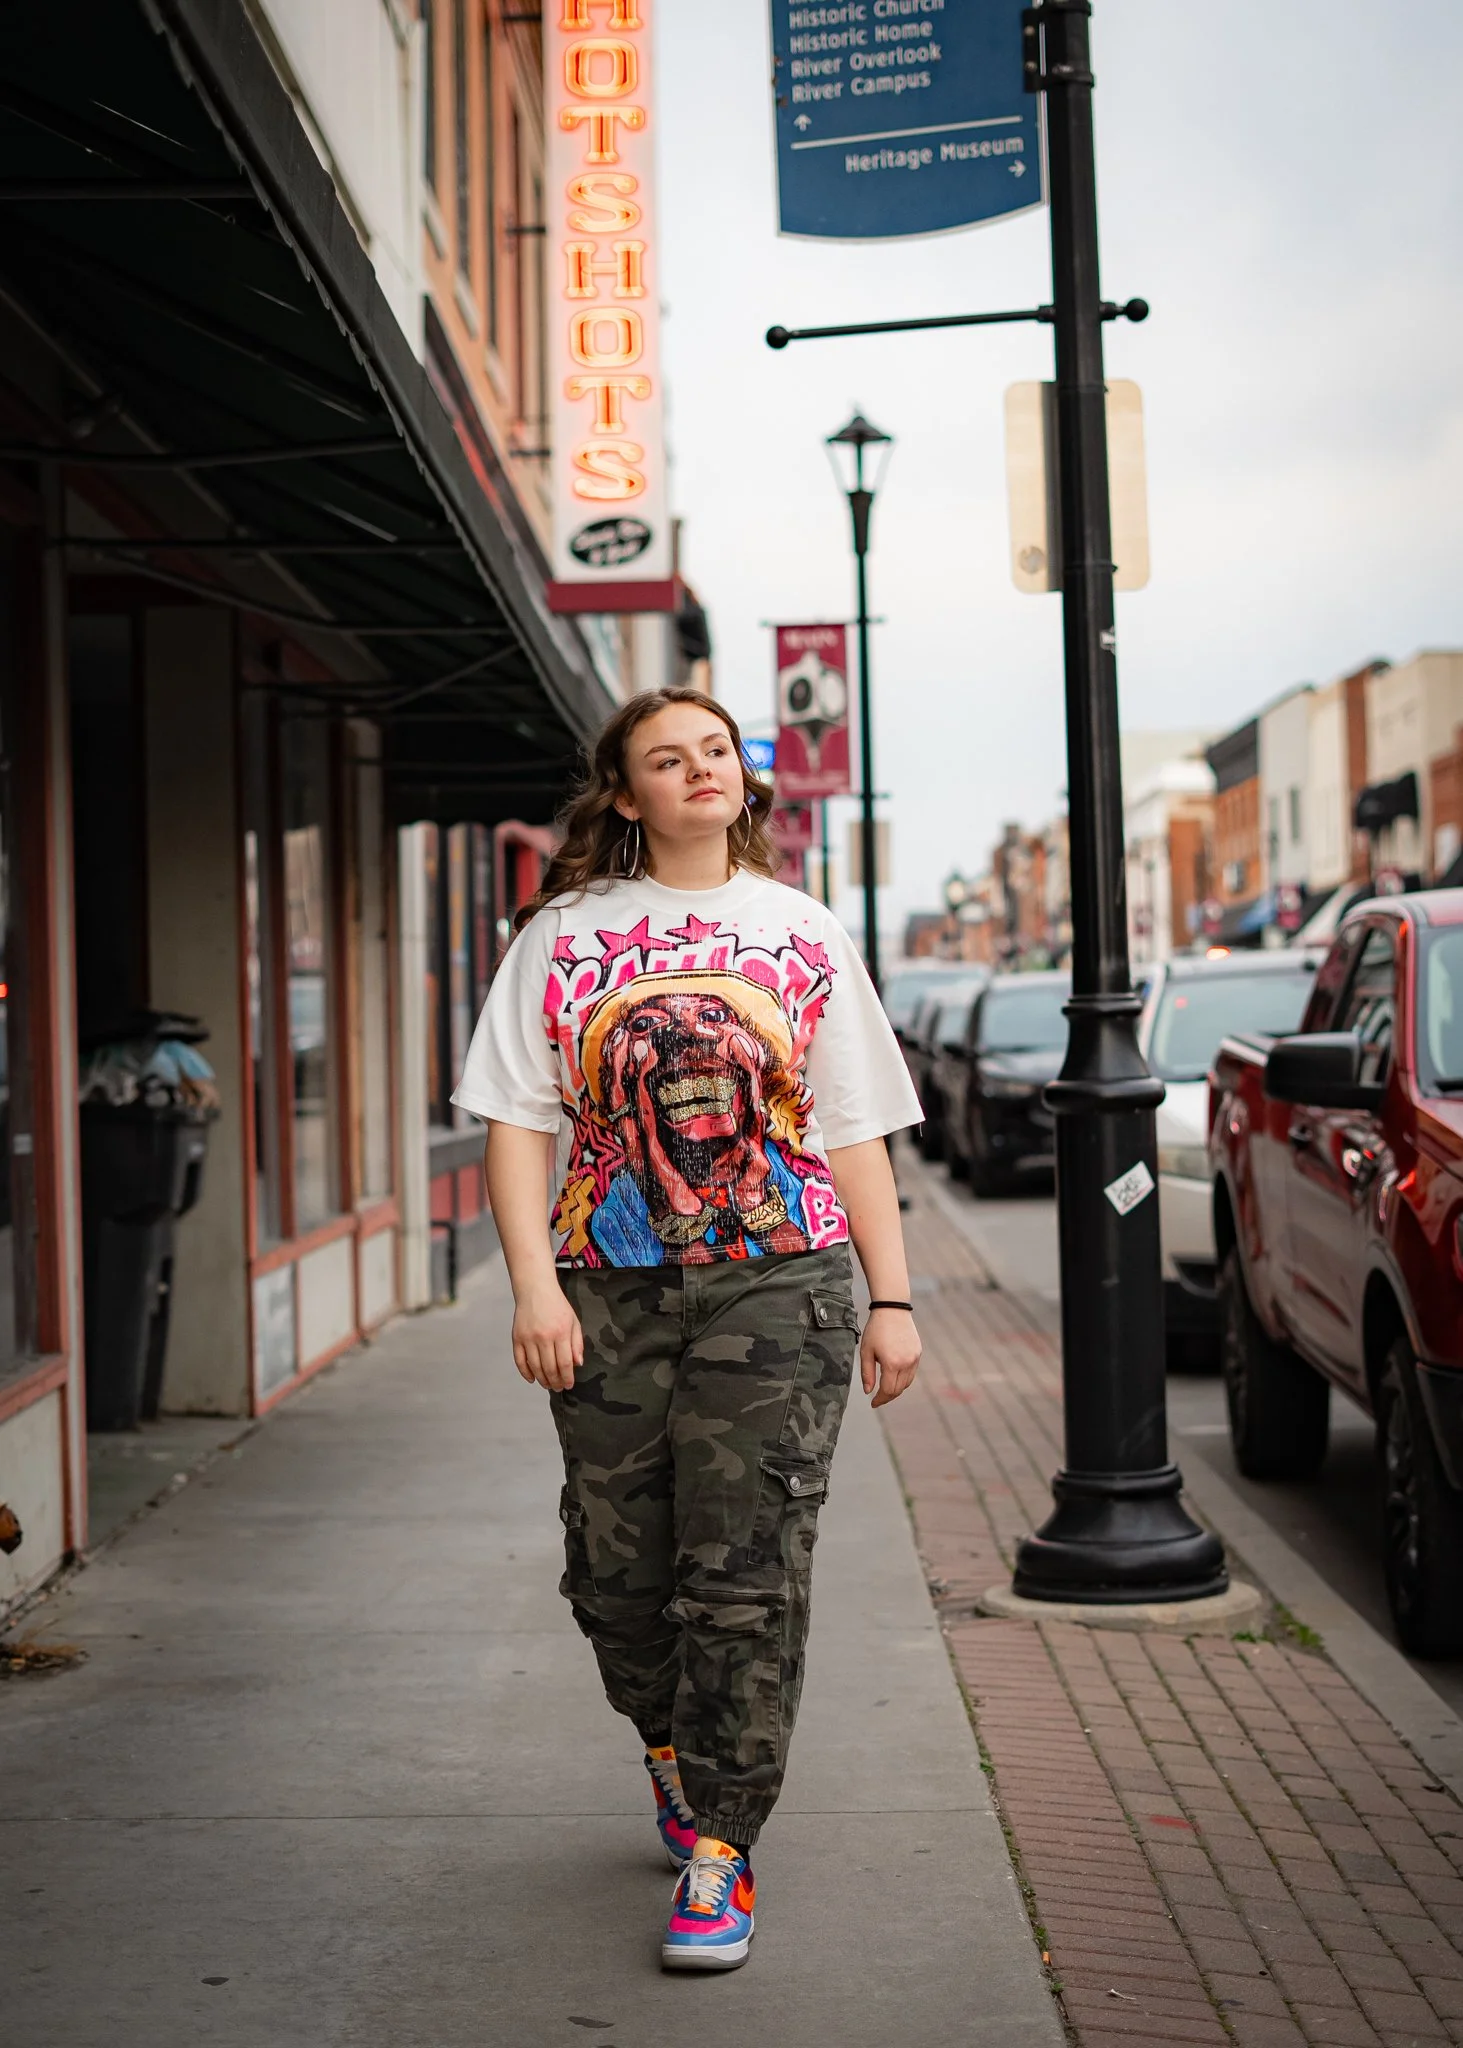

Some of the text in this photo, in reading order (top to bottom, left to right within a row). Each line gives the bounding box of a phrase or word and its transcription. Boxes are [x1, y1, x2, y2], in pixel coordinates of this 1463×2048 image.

[789, 0, 944, 29] Historic Church
[790, 21, 933, 54] Historic Home
[791, 41, 942, 78] River Overlook
[792, 71, 931, 104] River Campus
[845, 136, 1024, 173] Heritage Museum
